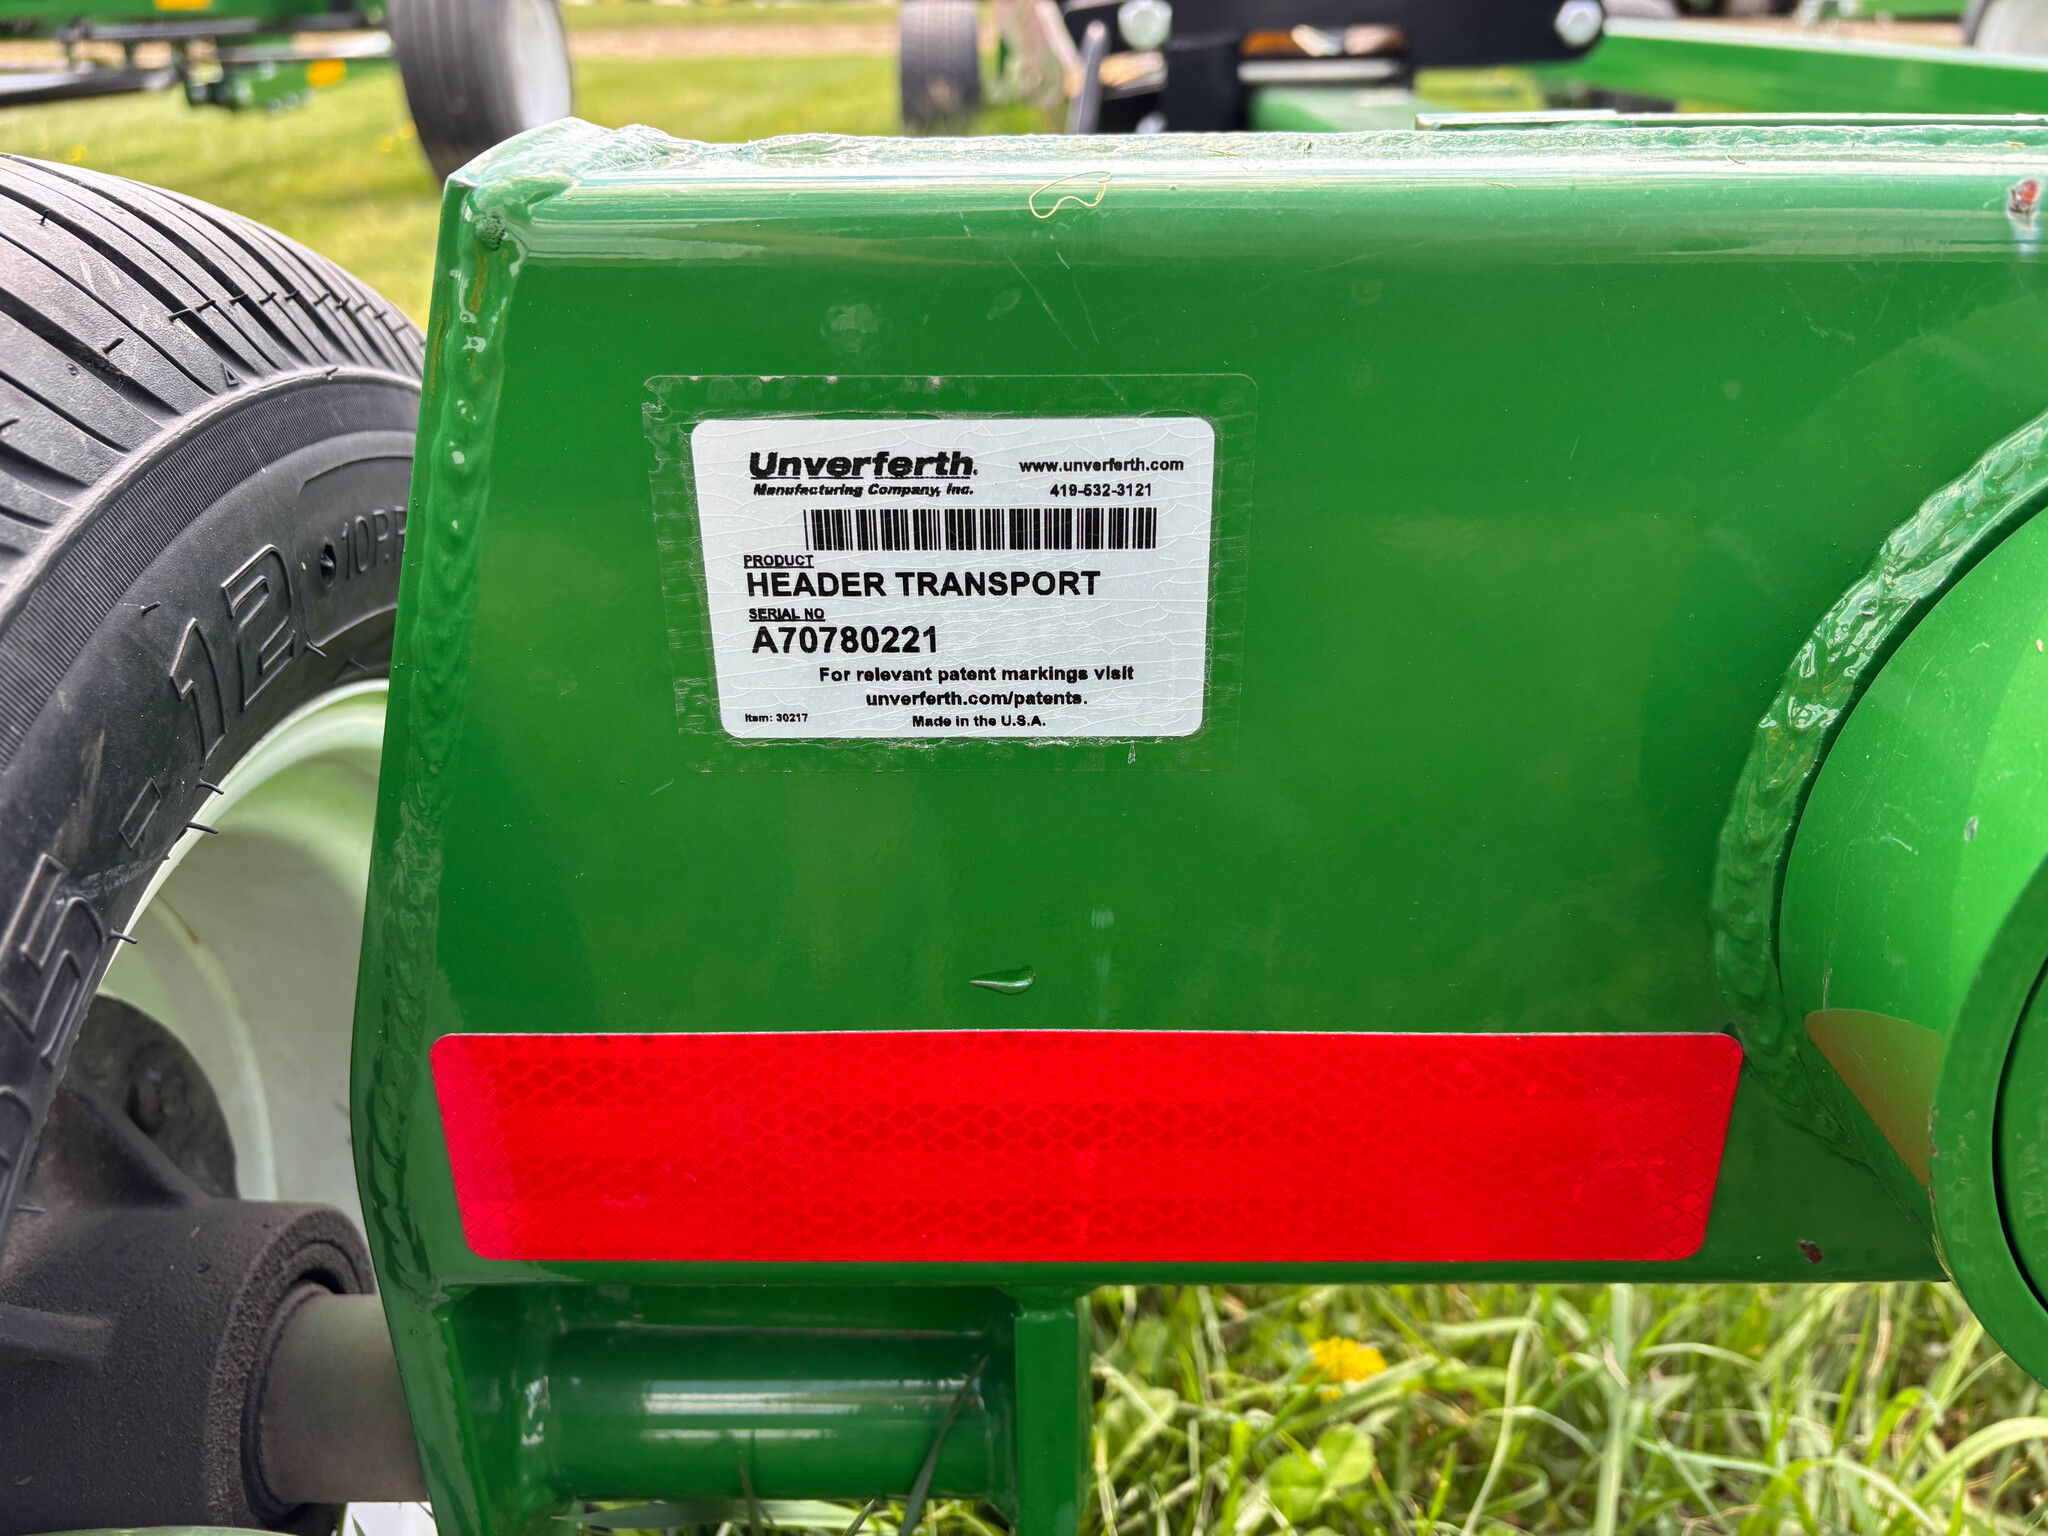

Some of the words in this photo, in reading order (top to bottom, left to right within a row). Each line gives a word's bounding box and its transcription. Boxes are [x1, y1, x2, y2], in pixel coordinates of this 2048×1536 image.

[1019, 457, 1184, 473] www.unverferth.com
[754, 484, 863, 498] Manufacturing
[868, 483, 941, 498] Company,
[947, 483, 974, 495] Inc.
[1050, 483, 1152, 497] 419-532-3121
[744, 555, 814, 569] PRODUCT
[747, 572, 887, 597] HEADER
[895, 571, 1101, 597] TRANSPORT
[749, 608, 799, 622] SERIAL
[803, 608, 826, 622] NO
[752, 626, 937, 654] A70780221
[819, 667, 851, 682] For
[857, 667, 932, 682] relevant
[938, 667, 996, 684] patent
[1002, 666, 1088, 684] markings
[1094, 666, 1134, 681] visit
[866, 691, 1088, 708] unverferth.com/patents.
[745, 713, 773, 723] Item:
[776, 713, 809, 723] 30217
[912, 716, 951, 727] Made
[955, 716, 970, 727] in
[974, 715, 996, 727] the
[1000, 715, 1046, 727] U.S.A.
